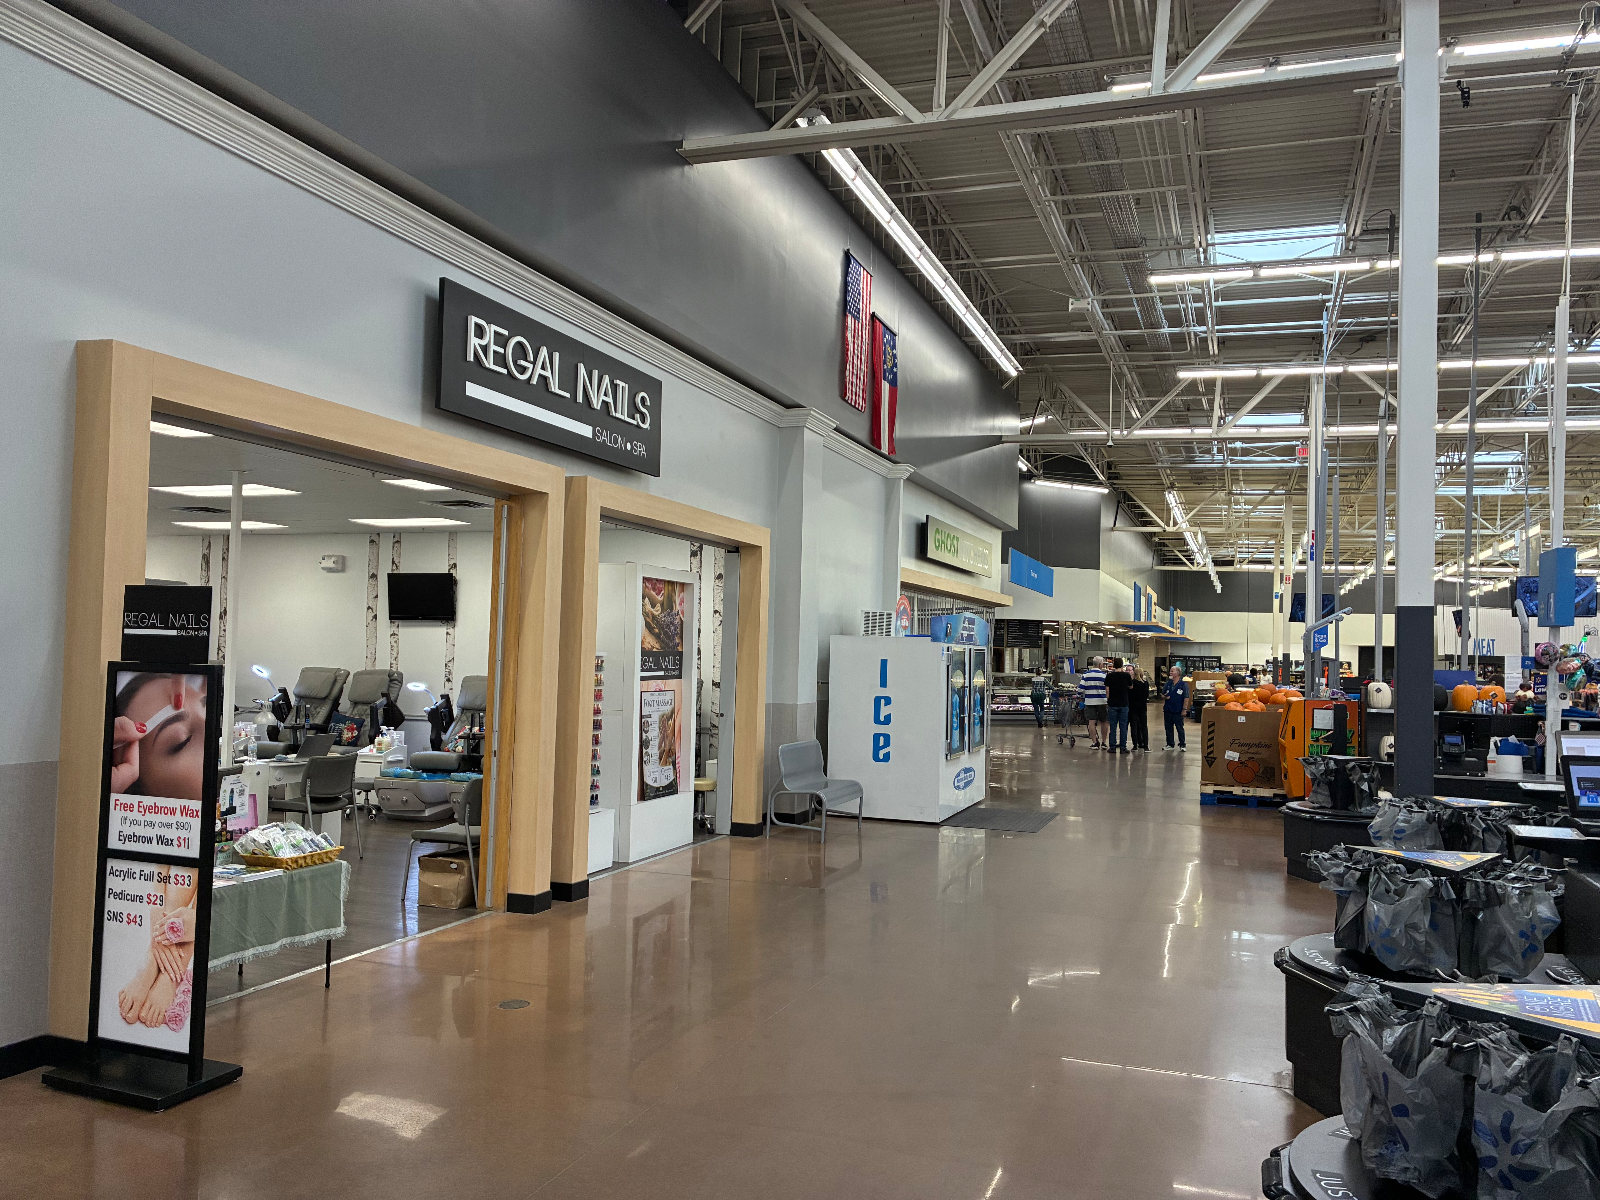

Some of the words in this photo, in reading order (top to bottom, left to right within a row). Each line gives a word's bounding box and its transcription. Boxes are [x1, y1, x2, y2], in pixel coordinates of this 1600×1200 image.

[466, 314, 571, 399] REGAL
[576, 362, 651, 430] NAILS
[595, 426, 625, 451] SALON
[632, 440, 647, 459] SPA
[934, 528, 959, 558] GHOST
[124, 612, 165, 628] REGAL
[169, 613, 209, 628] NAILS
[177, 629, 195, 637] SALON
[1473, 638, 1496, 656] MEAT
[114, 799, 134, 813] Free
[137, 801, 177, 816] Eyebrow
[179, 804, 200, 819] Wax
[128, 818, 141, 827] you
[143, 820, 156, 829] pay
[158, 821, 173, 830] over
[175, 820, 192, 833] $90)
[118, 830, 154, 845] Eyebrow
[156, 834, 174, 847] Wax
[176, 836, 190, 850] $11
[108, 865, 137, 881] Acrylic
[139, 869, 154, 882] Full
[156, 871, 172, 884] Set
[173, 874, 192, 887] $33
[107, 887, 144, 903] Pedicure
[146, 892, 164, 907] $29
[106, 910, 124, 924] SNS
[125, 913, 143, 927] $43
[1315, 1173, 1359, 1200] JUS
